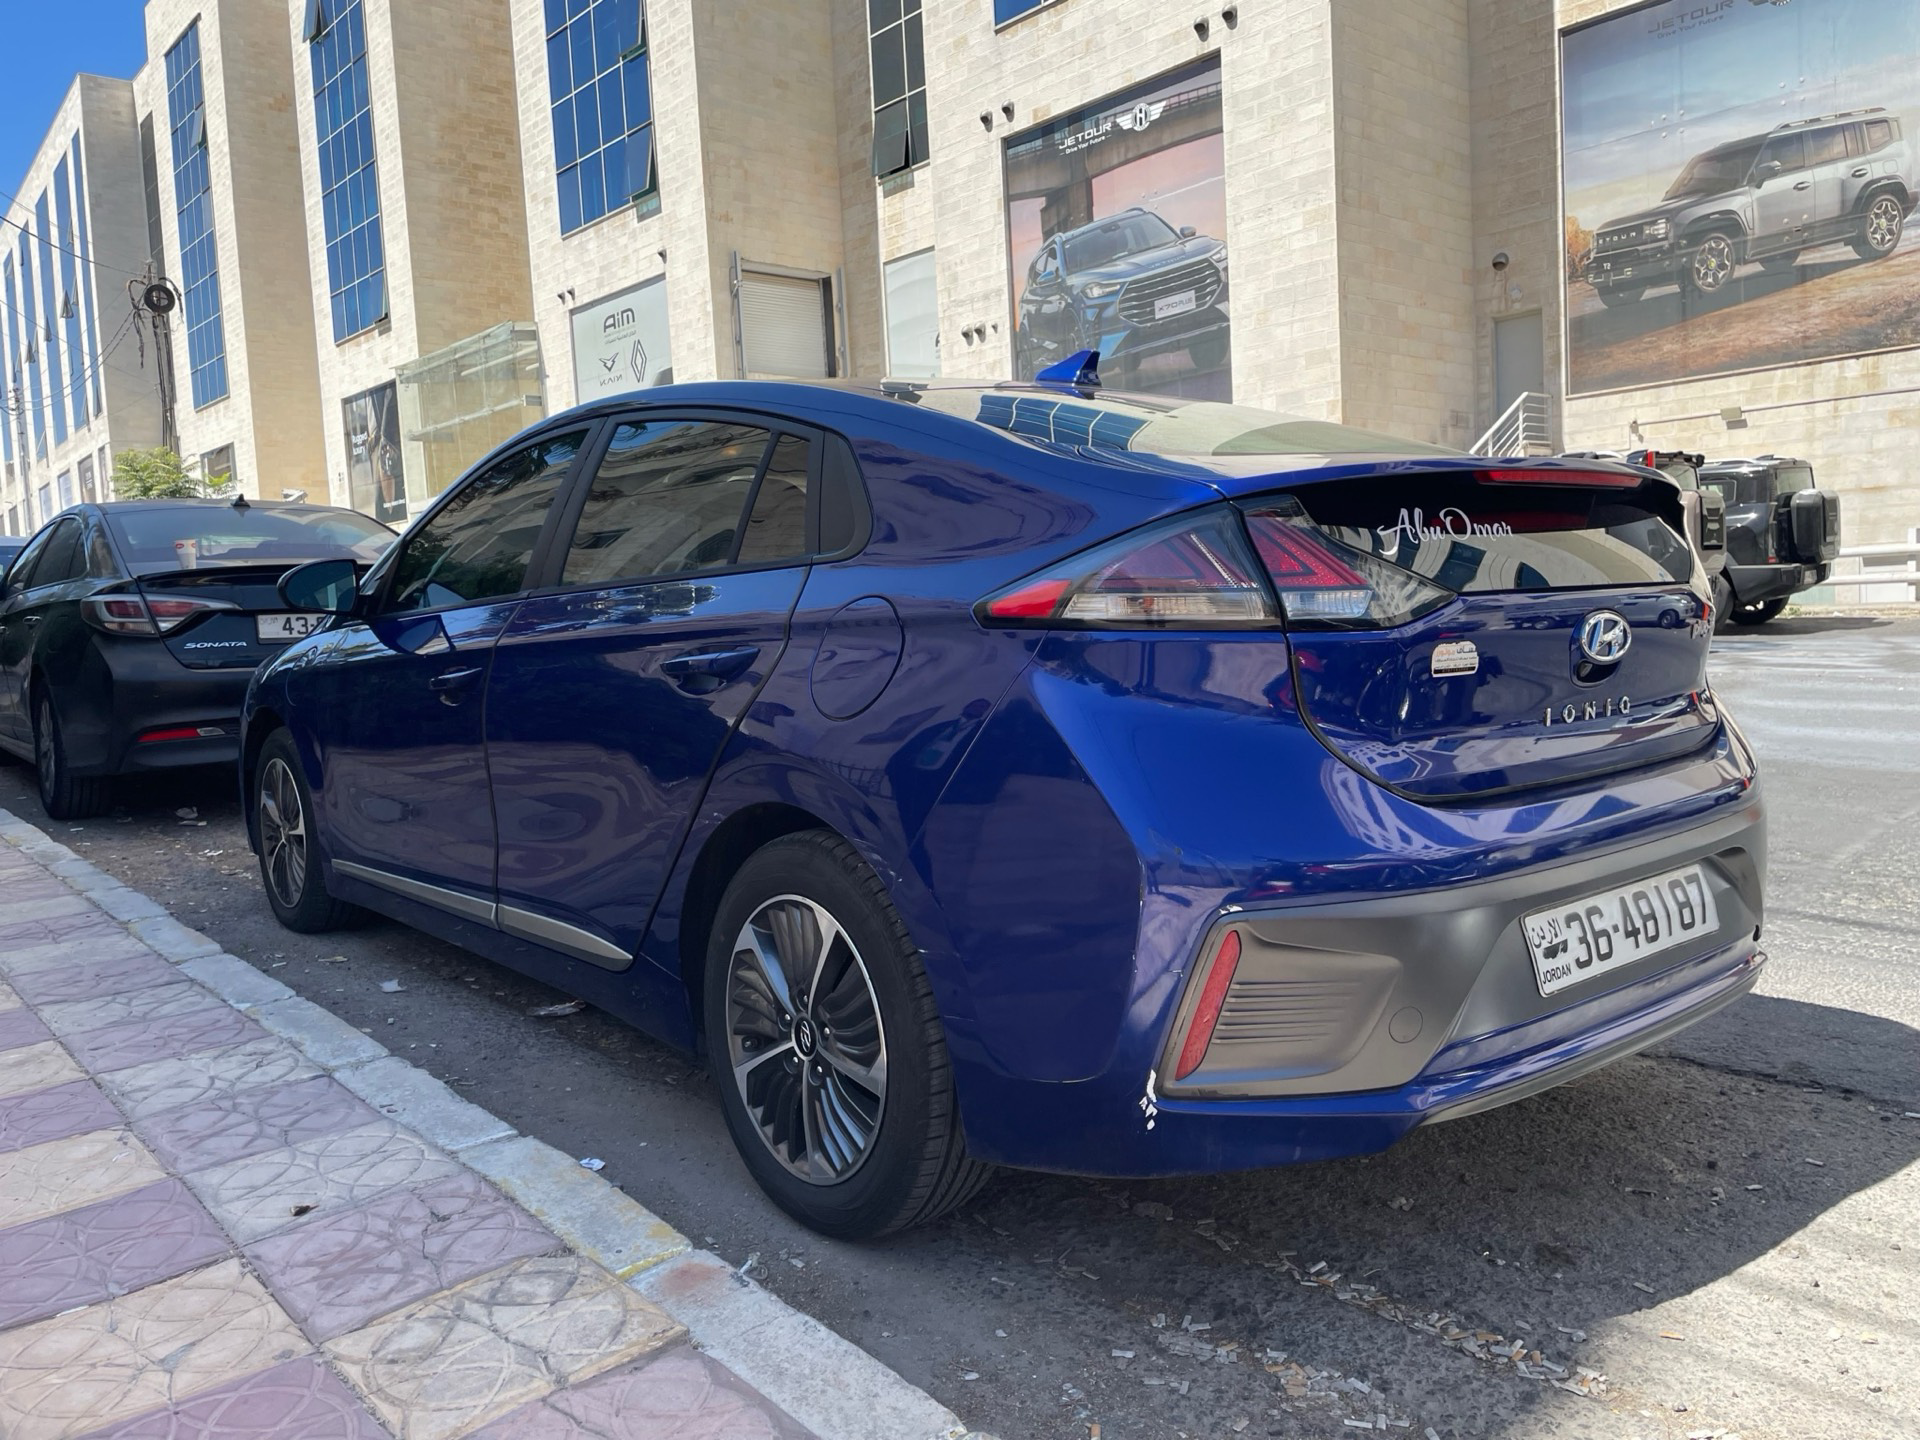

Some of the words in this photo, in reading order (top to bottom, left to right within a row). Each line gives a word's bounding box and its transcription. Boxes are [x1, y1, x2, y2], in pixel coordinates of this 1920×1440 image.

[1648, 0, 1733, 34] JETOUR
[1657, 28, 1676, 39] Drive
[1679, 22, 1696, 32] Your
[1699, 14, 1724, 26] Future
[1059, 122, 1112, 149] JETOUR
[1065, 145, 1078, 155] Drive
[1078, 140, 1089, 150] Your
[1090, 135, 1106, 146] Future
[184, 641, 247, 649] SONATA
[1544, 695, 1630, 727] IONIQ
[1565, 872, 1706, 970] 36-48187
[1542, 962, 1572, 985] JORDAN
